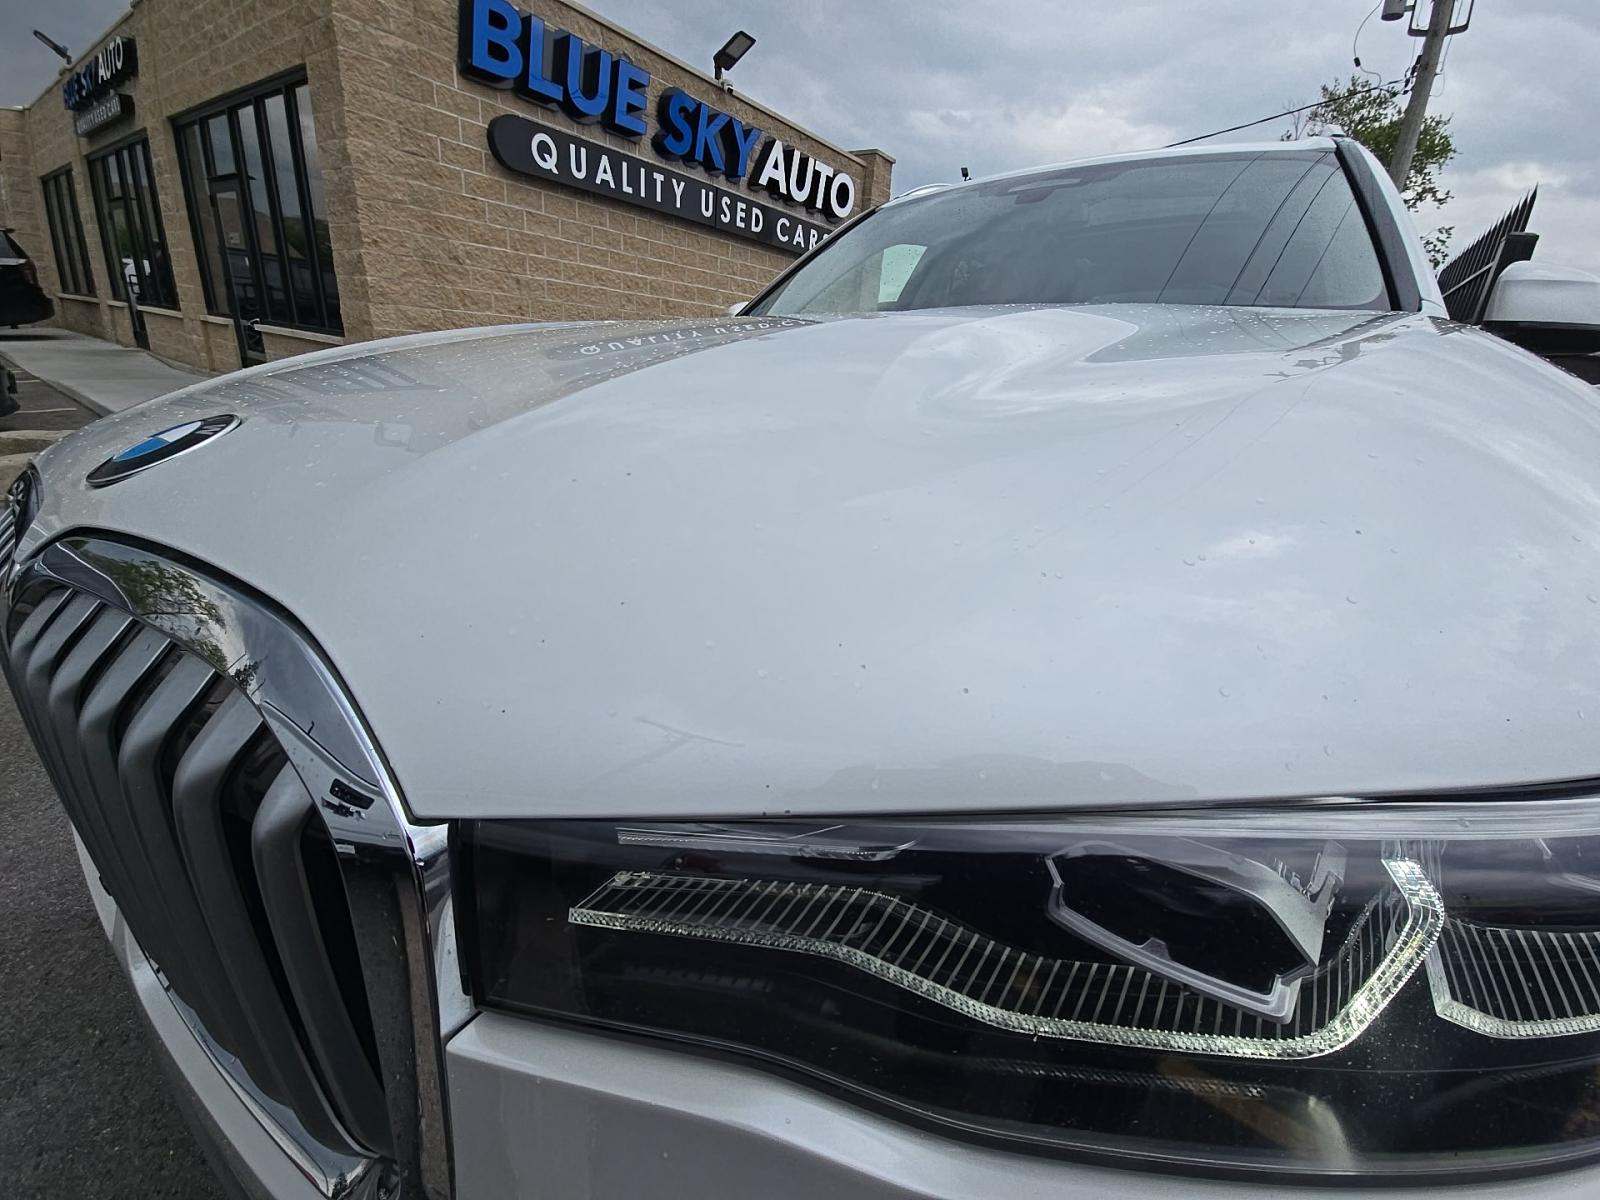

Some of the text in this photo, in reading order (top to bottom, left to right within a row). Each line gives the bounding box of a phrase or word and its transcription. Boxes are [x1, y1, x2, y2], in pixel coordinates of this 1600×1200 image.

[98, 36, 123, 84] AUTO
[472, 0, 855, 218] BLUE SKY AUTO
[531, 133, 686, 209] QUALITY
[701, 189, 764, 234] USED
